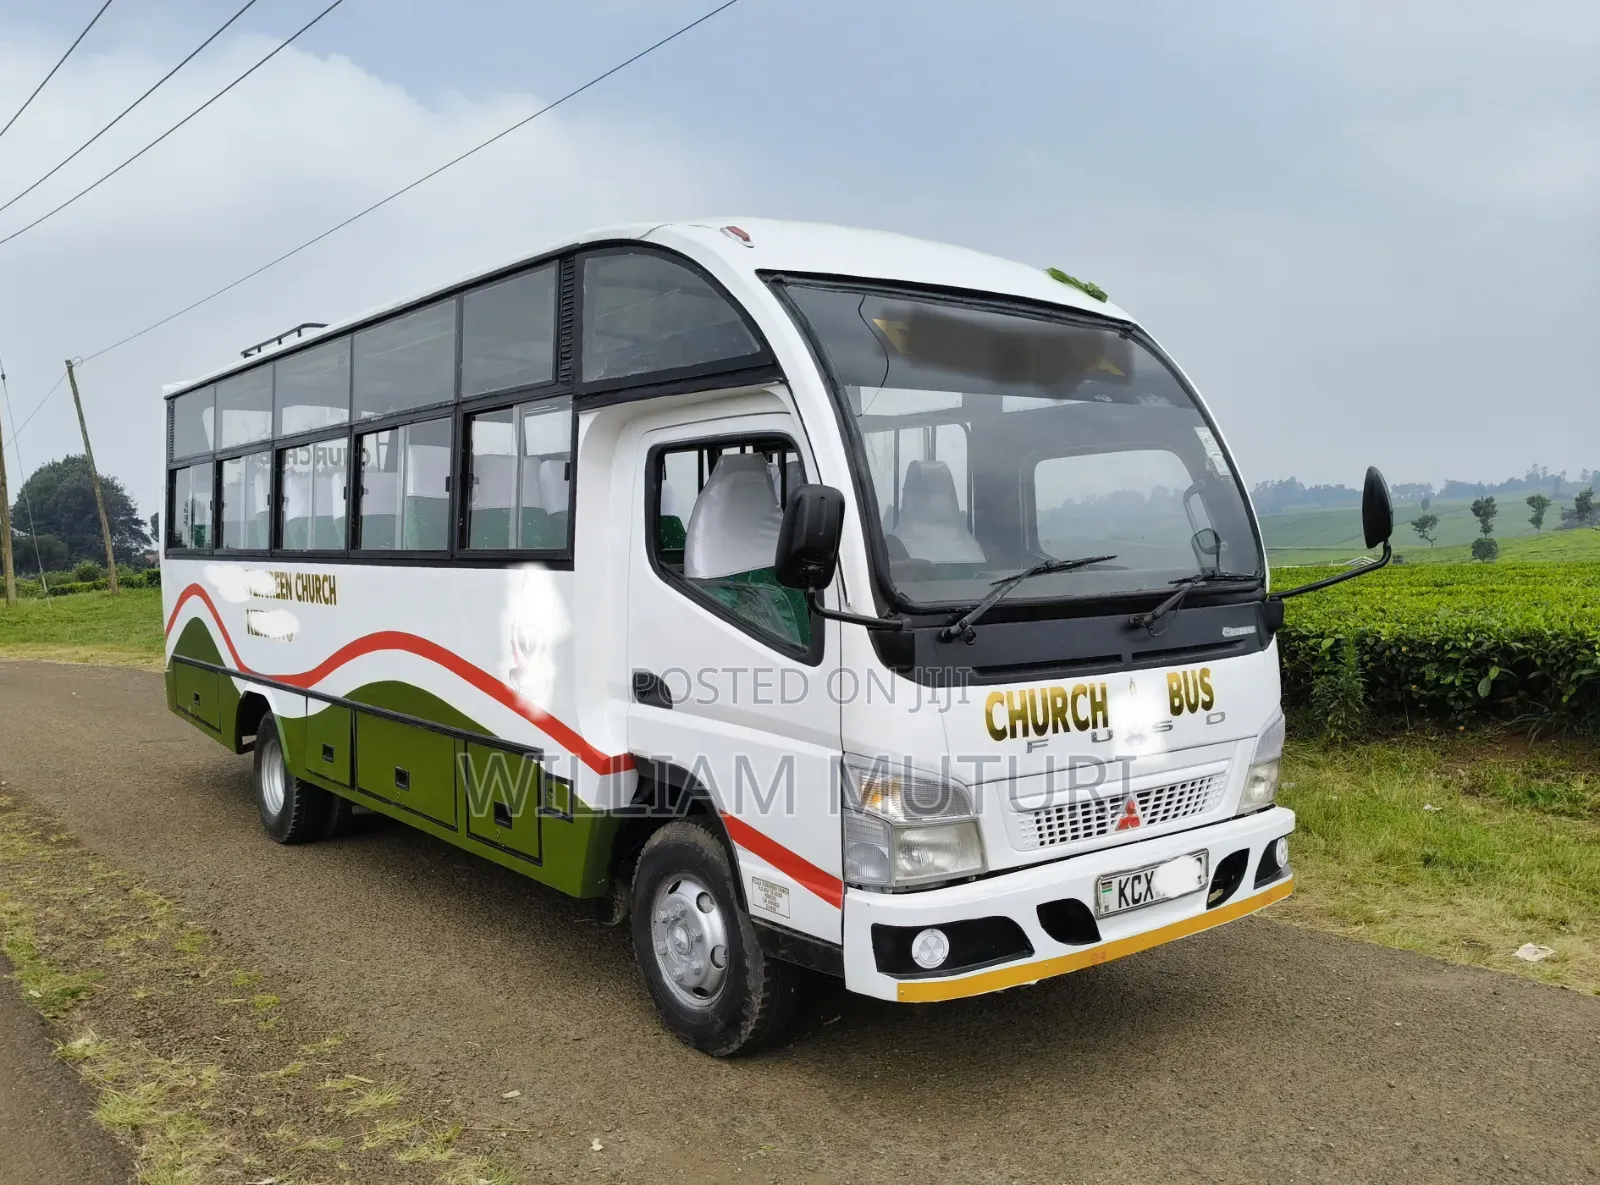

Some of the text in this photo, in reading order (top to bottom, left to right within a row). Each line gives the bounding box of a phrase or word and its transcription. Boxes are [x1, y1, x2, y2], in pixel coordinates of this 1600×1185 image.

[295, 572, 337, 605] CHURCH
[985, 667, 1215, 742] CHURCH BUS
[1118, 870, 1154, 909] KCX
